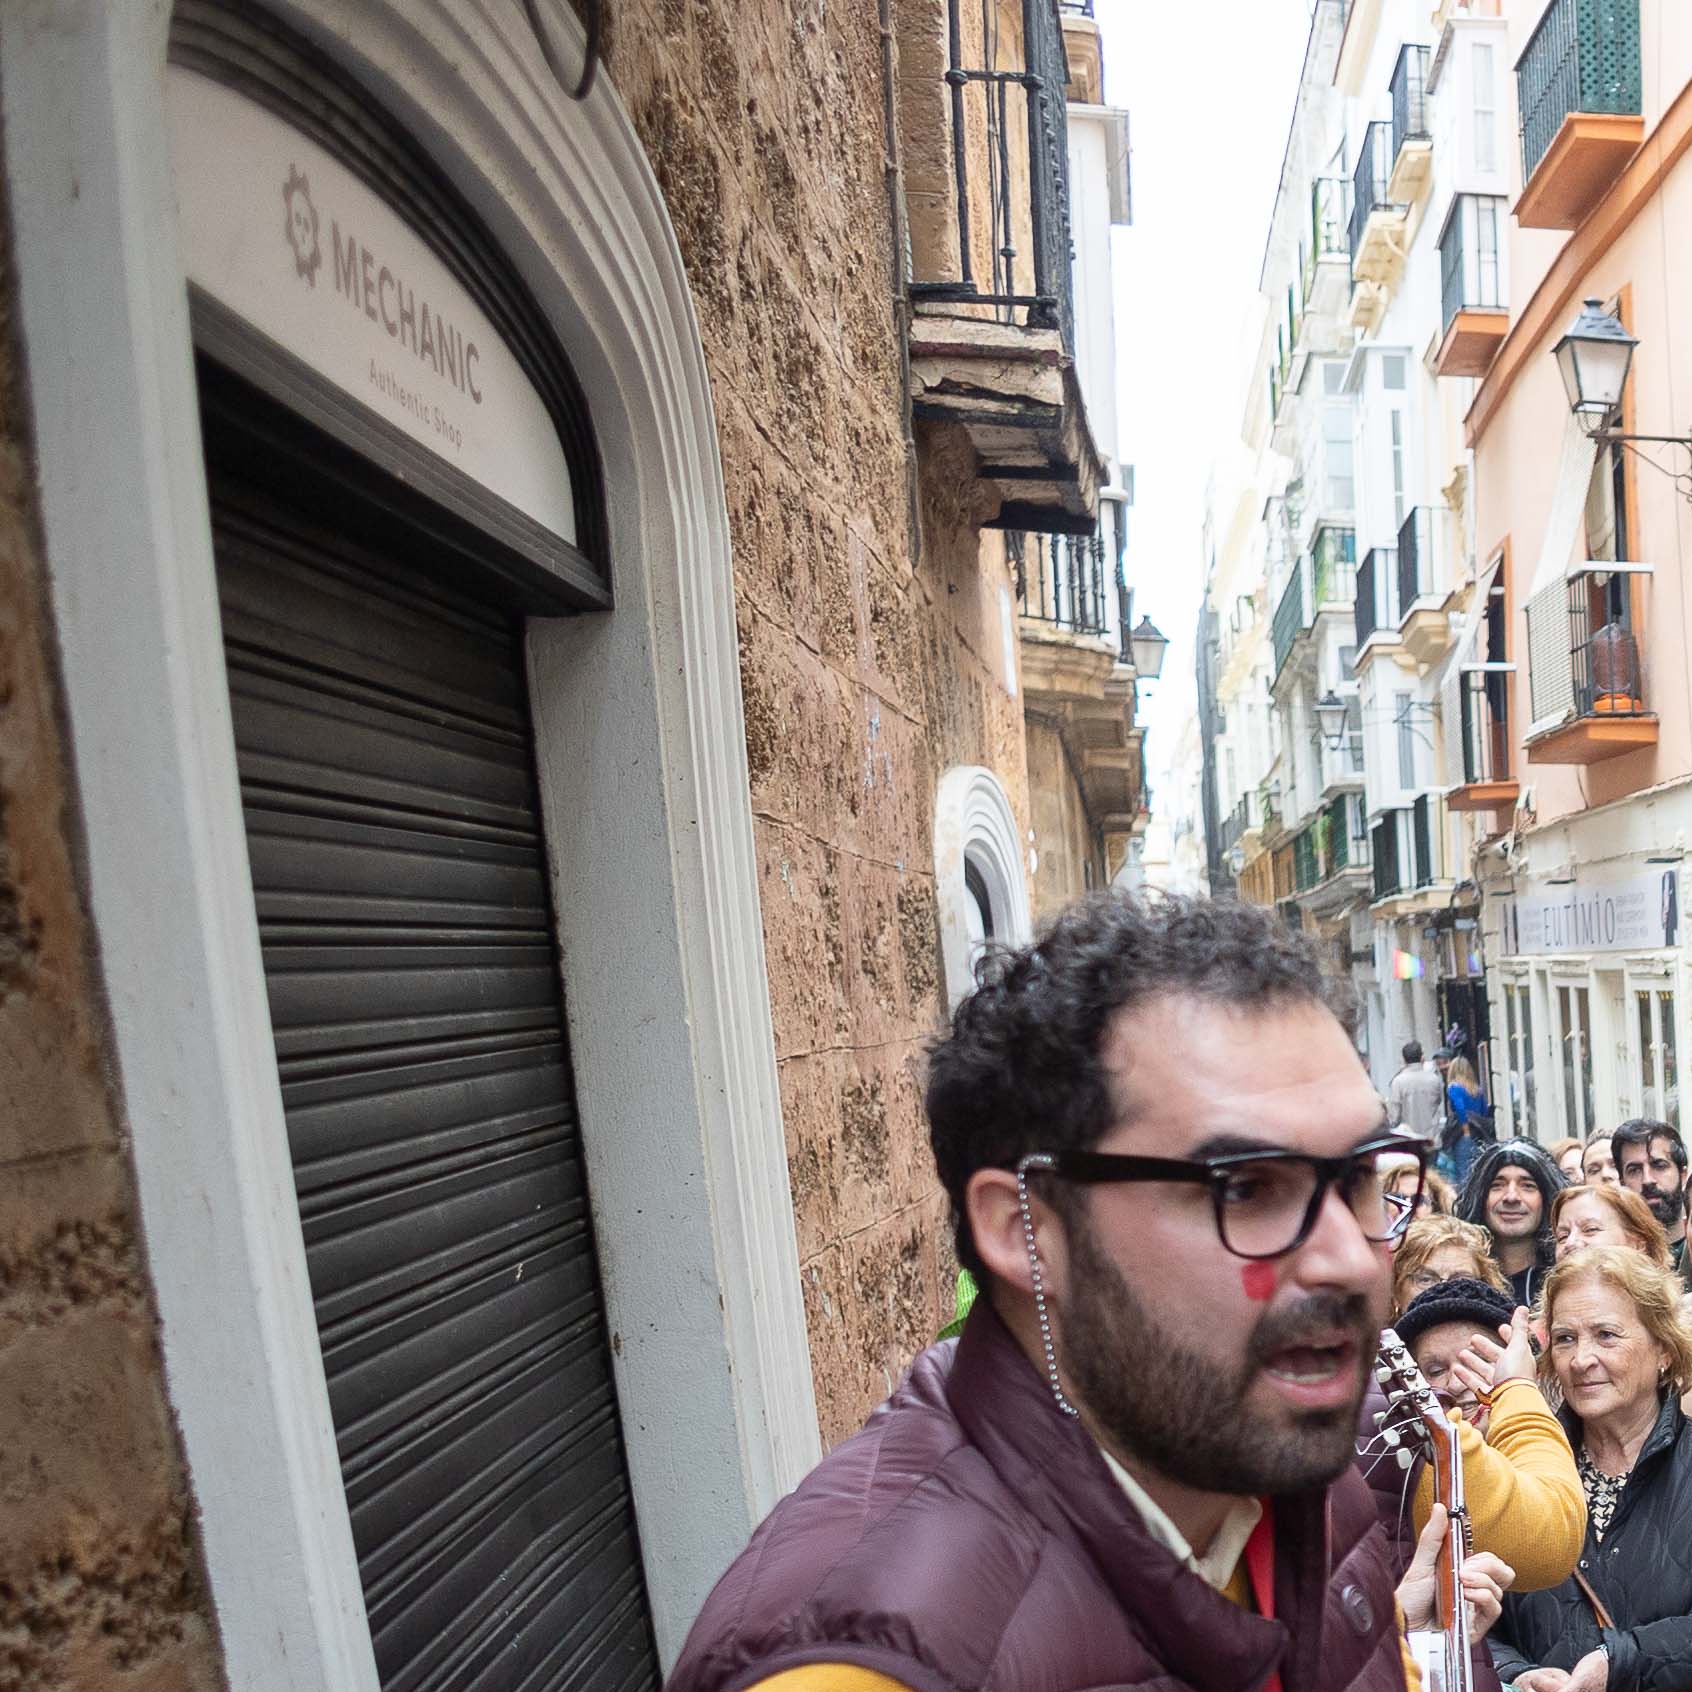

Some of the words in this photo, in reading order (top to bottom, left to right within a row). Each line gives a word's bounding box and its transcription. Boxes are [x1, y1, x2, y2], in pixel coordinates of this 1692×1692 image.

[332, 219, 482, 404] MECHANIC
[370, 359, 430, 424] Authentic
[434, 407, 462, 452] Shop
